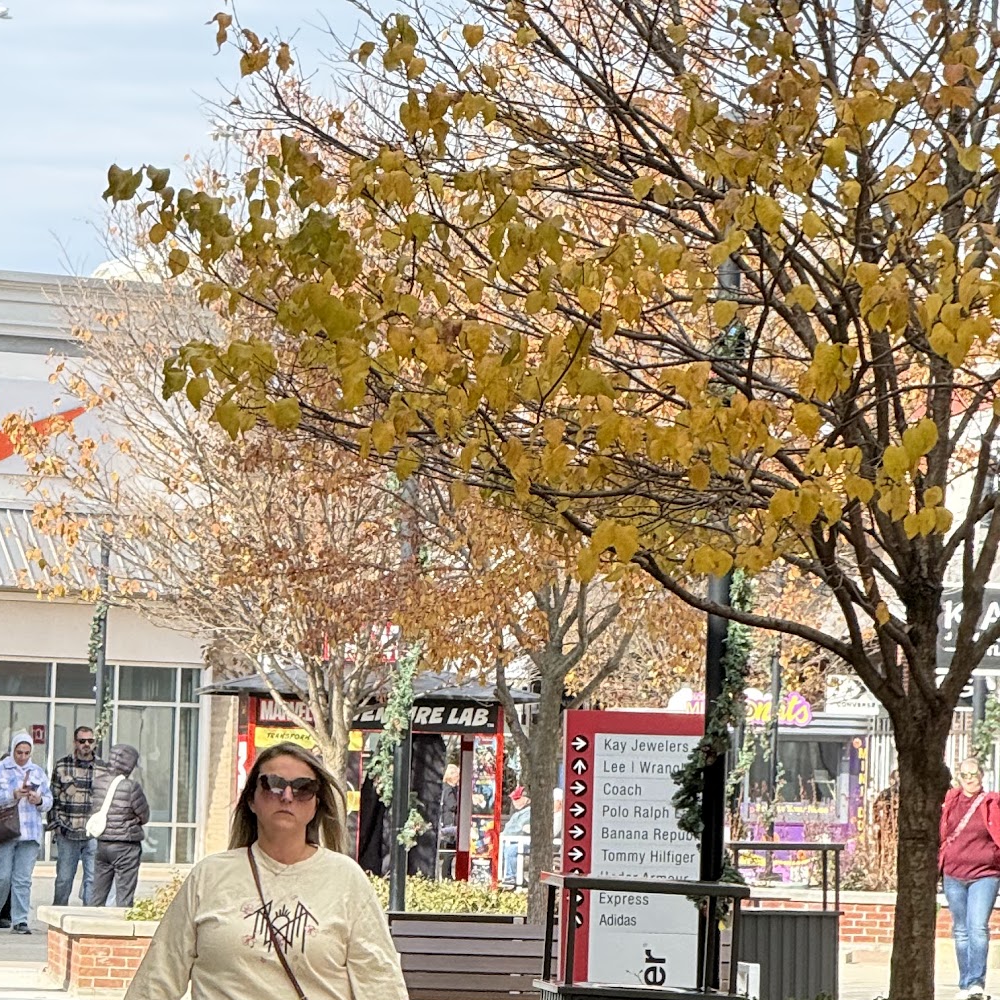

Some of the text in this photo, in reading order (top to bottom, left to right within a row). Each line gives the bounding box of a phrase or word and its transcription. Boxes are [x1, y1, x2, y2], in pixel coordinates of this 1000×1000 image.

[604, 738, 689, 753] Kay Jewelers
[603, 761, 626, 773] Lee
[639, 761, 685, 775] Wrangl
[603, 783, 642, 796] Coach
[602, 805, 629, 818] Polo
[634, 805, 670, 821] Ralph
[601, 827, 695, 844] Banana Repub
[601, 849, 696, 866] Tommy Hilfiger
[599, 892, 650, 907] Express
[599, 914, 637, 926] Adidas
